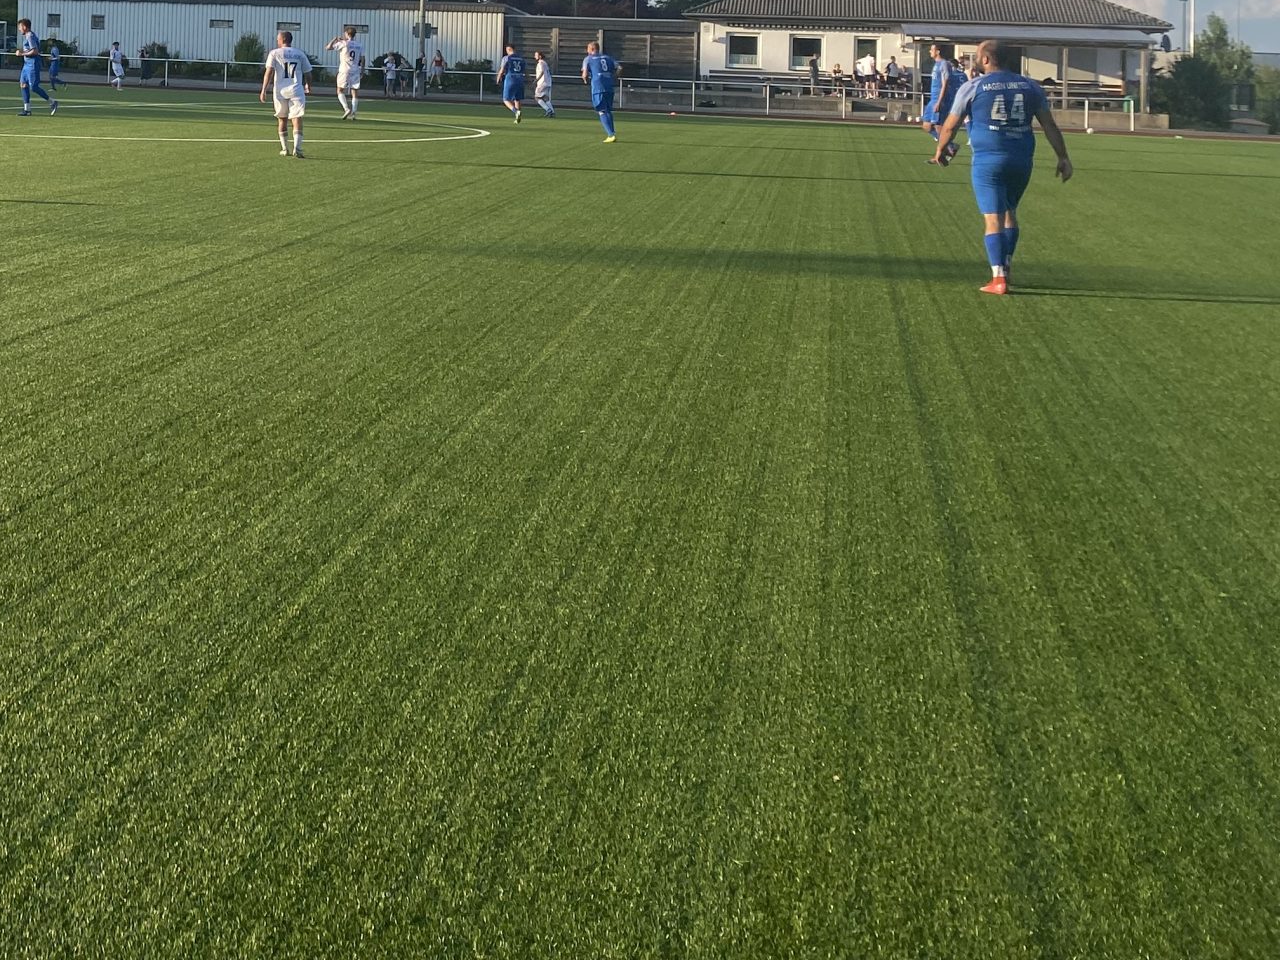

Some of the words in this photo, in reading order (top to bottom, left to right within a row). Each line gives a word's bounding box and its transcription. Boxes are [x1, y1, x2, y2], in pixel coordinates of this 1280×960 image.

[283, 62, 298, 79] 17
[600, 58, 608, 72] 8
[1006, 81, 1032, 90] UNITE
[991, 93, 1026, 125] 44
